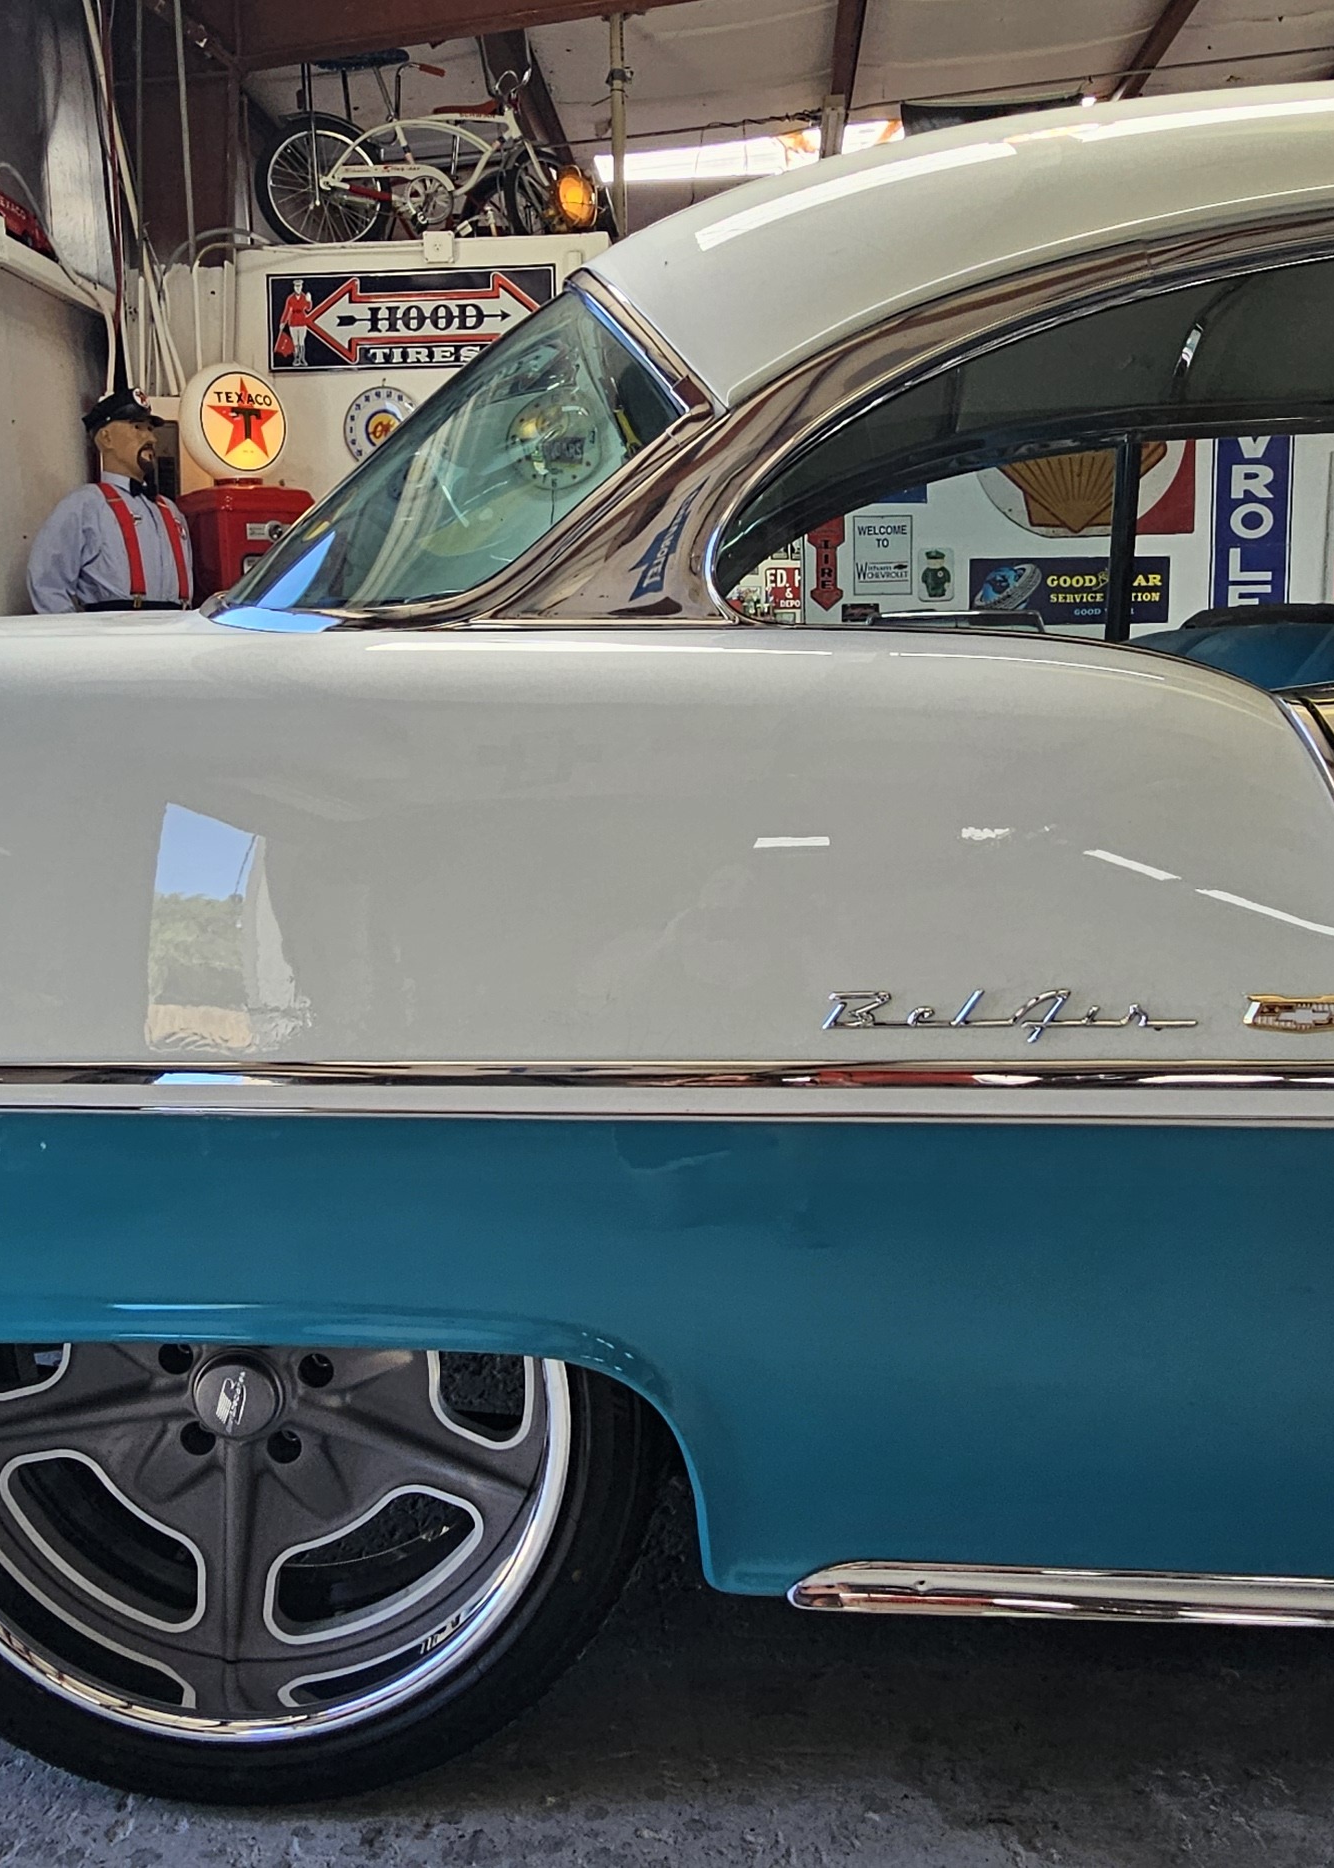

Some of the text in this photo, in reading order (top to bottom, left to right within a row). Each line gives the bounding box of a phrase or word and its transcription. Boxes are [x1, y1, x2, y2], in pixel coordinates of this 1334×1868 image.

[368, 303, 484, 333] HOOD
[370, 346, 480, 363] TIRES
[214, 391, 272, 406] TEXACO
[858, 524, 907, 536] WELCOME
[875, 538, 890, 548] TO
[1047, 574, 1162, 588] GOODAR
[1050, 593, 1104, 603] SERVICE
[1074, 608, 1101, 616] GOOD
